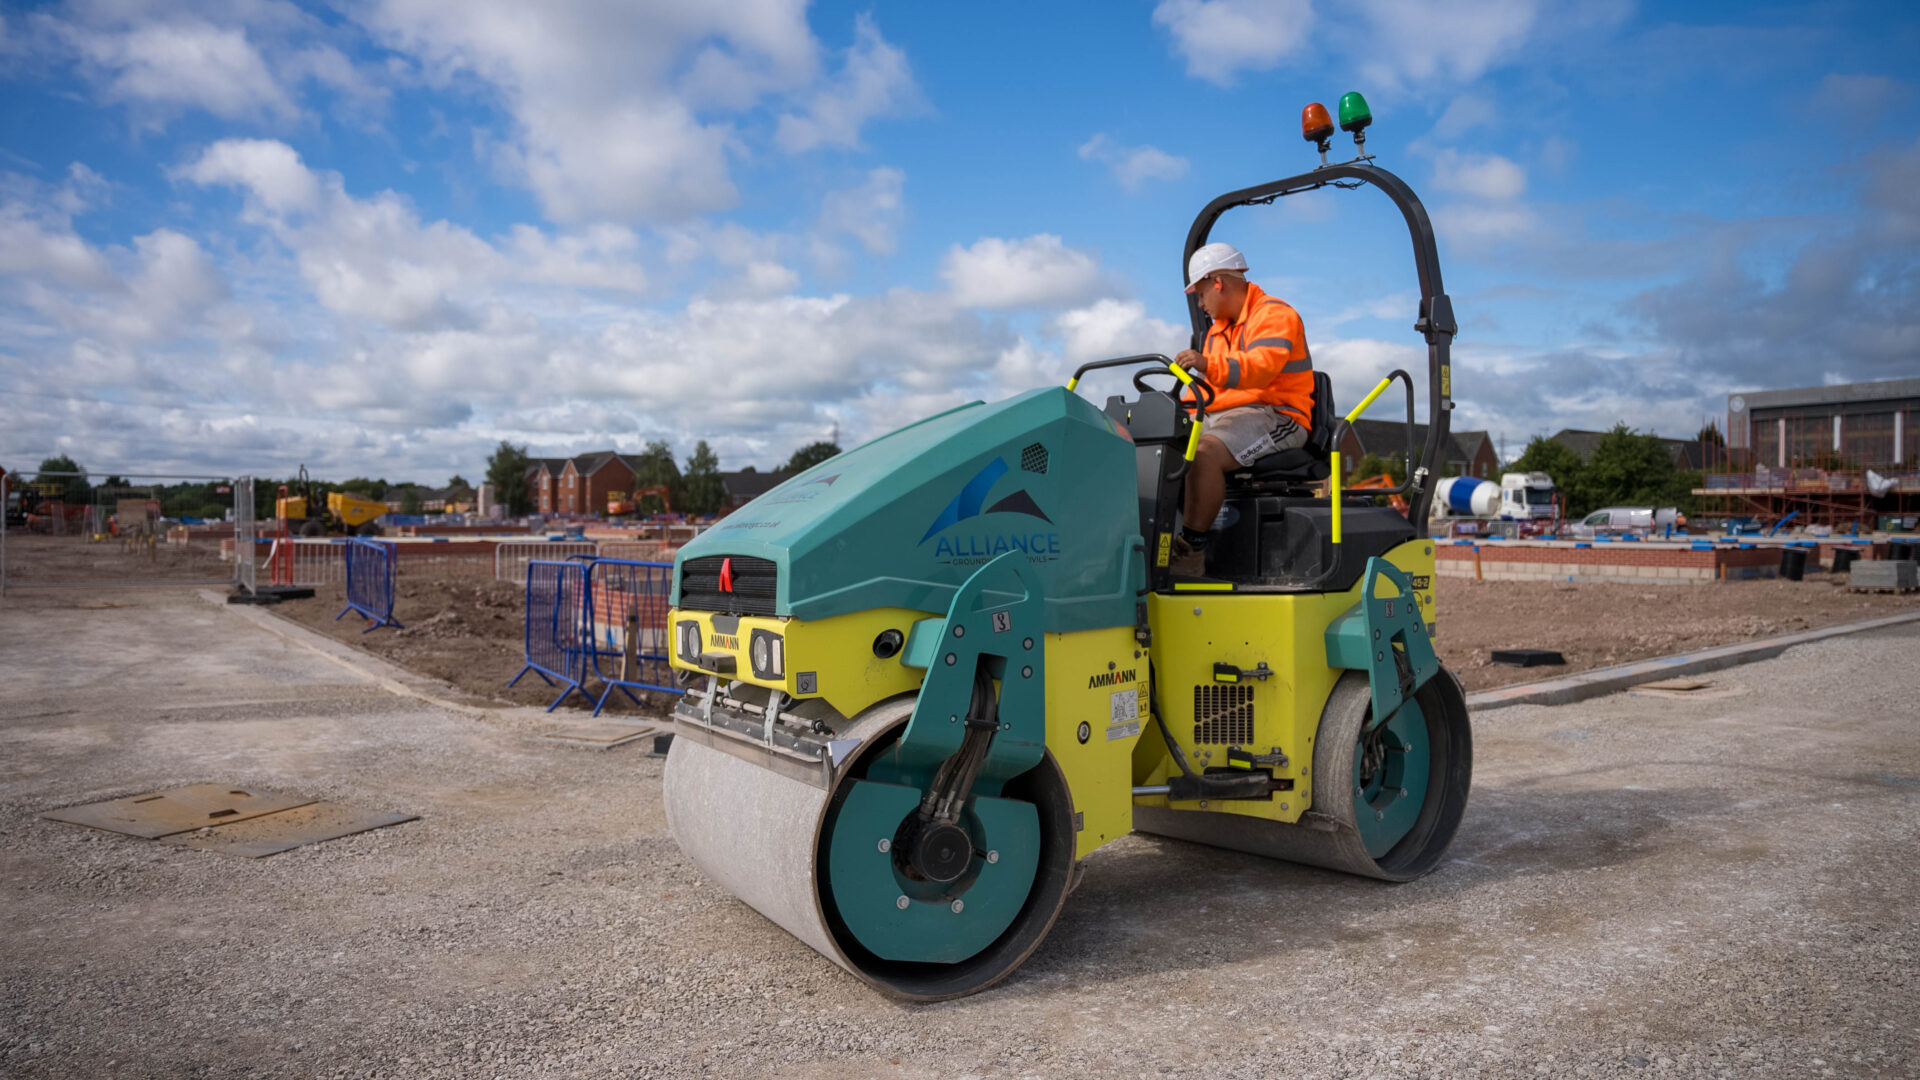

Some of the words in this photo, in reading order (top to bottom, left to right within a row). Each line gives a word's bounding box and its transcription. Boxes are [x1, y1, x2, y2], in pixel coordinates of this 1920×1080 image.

[1240, 444, 1263, 459] adidas
[935, 533, 1060, 557] ALLIANCE
[952, 557, 992, 566] GROUND
[710, 634, 739, 650] AMMANN
[1088, 669, 1136, 689] AMMANN
